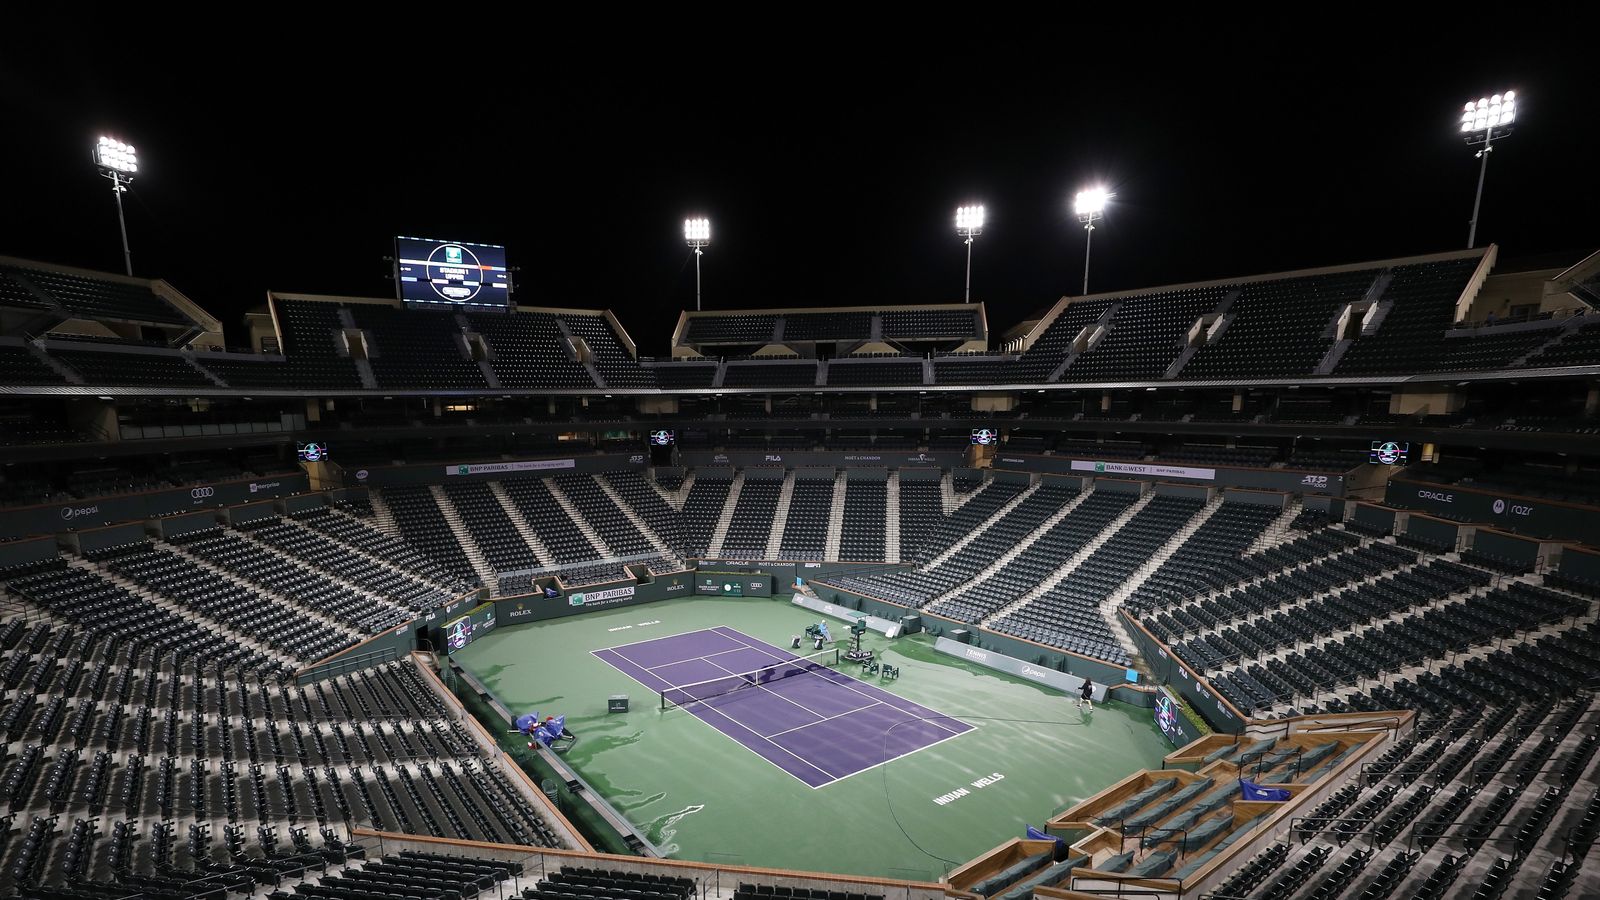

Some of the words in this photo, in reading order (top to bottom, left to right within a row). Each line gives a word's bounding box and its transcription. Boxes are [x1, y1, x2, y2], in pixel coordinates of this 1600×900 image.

[1106, 463, 1123, 471] BANK
[1418, 490, 1453, 503] ORACLE
[75, 505, 99, 517] pepsi
[1511, 504, 1534, 516] razr
[585, 593, 600, 601] BNP
[602, 588, 632, 598] PARIBAS
[667, 585, 684, 593] ROLEX
[425, 613, 436, 621] FILA
[510, 608, 532, 617] ROLEX
[966, 648, 987, 659] TENNIS
[1179, 666, 1189, 679] FILA
[932, 787, 971, 806] INDIAN
[970, 772, 1005, 789] WELLS
